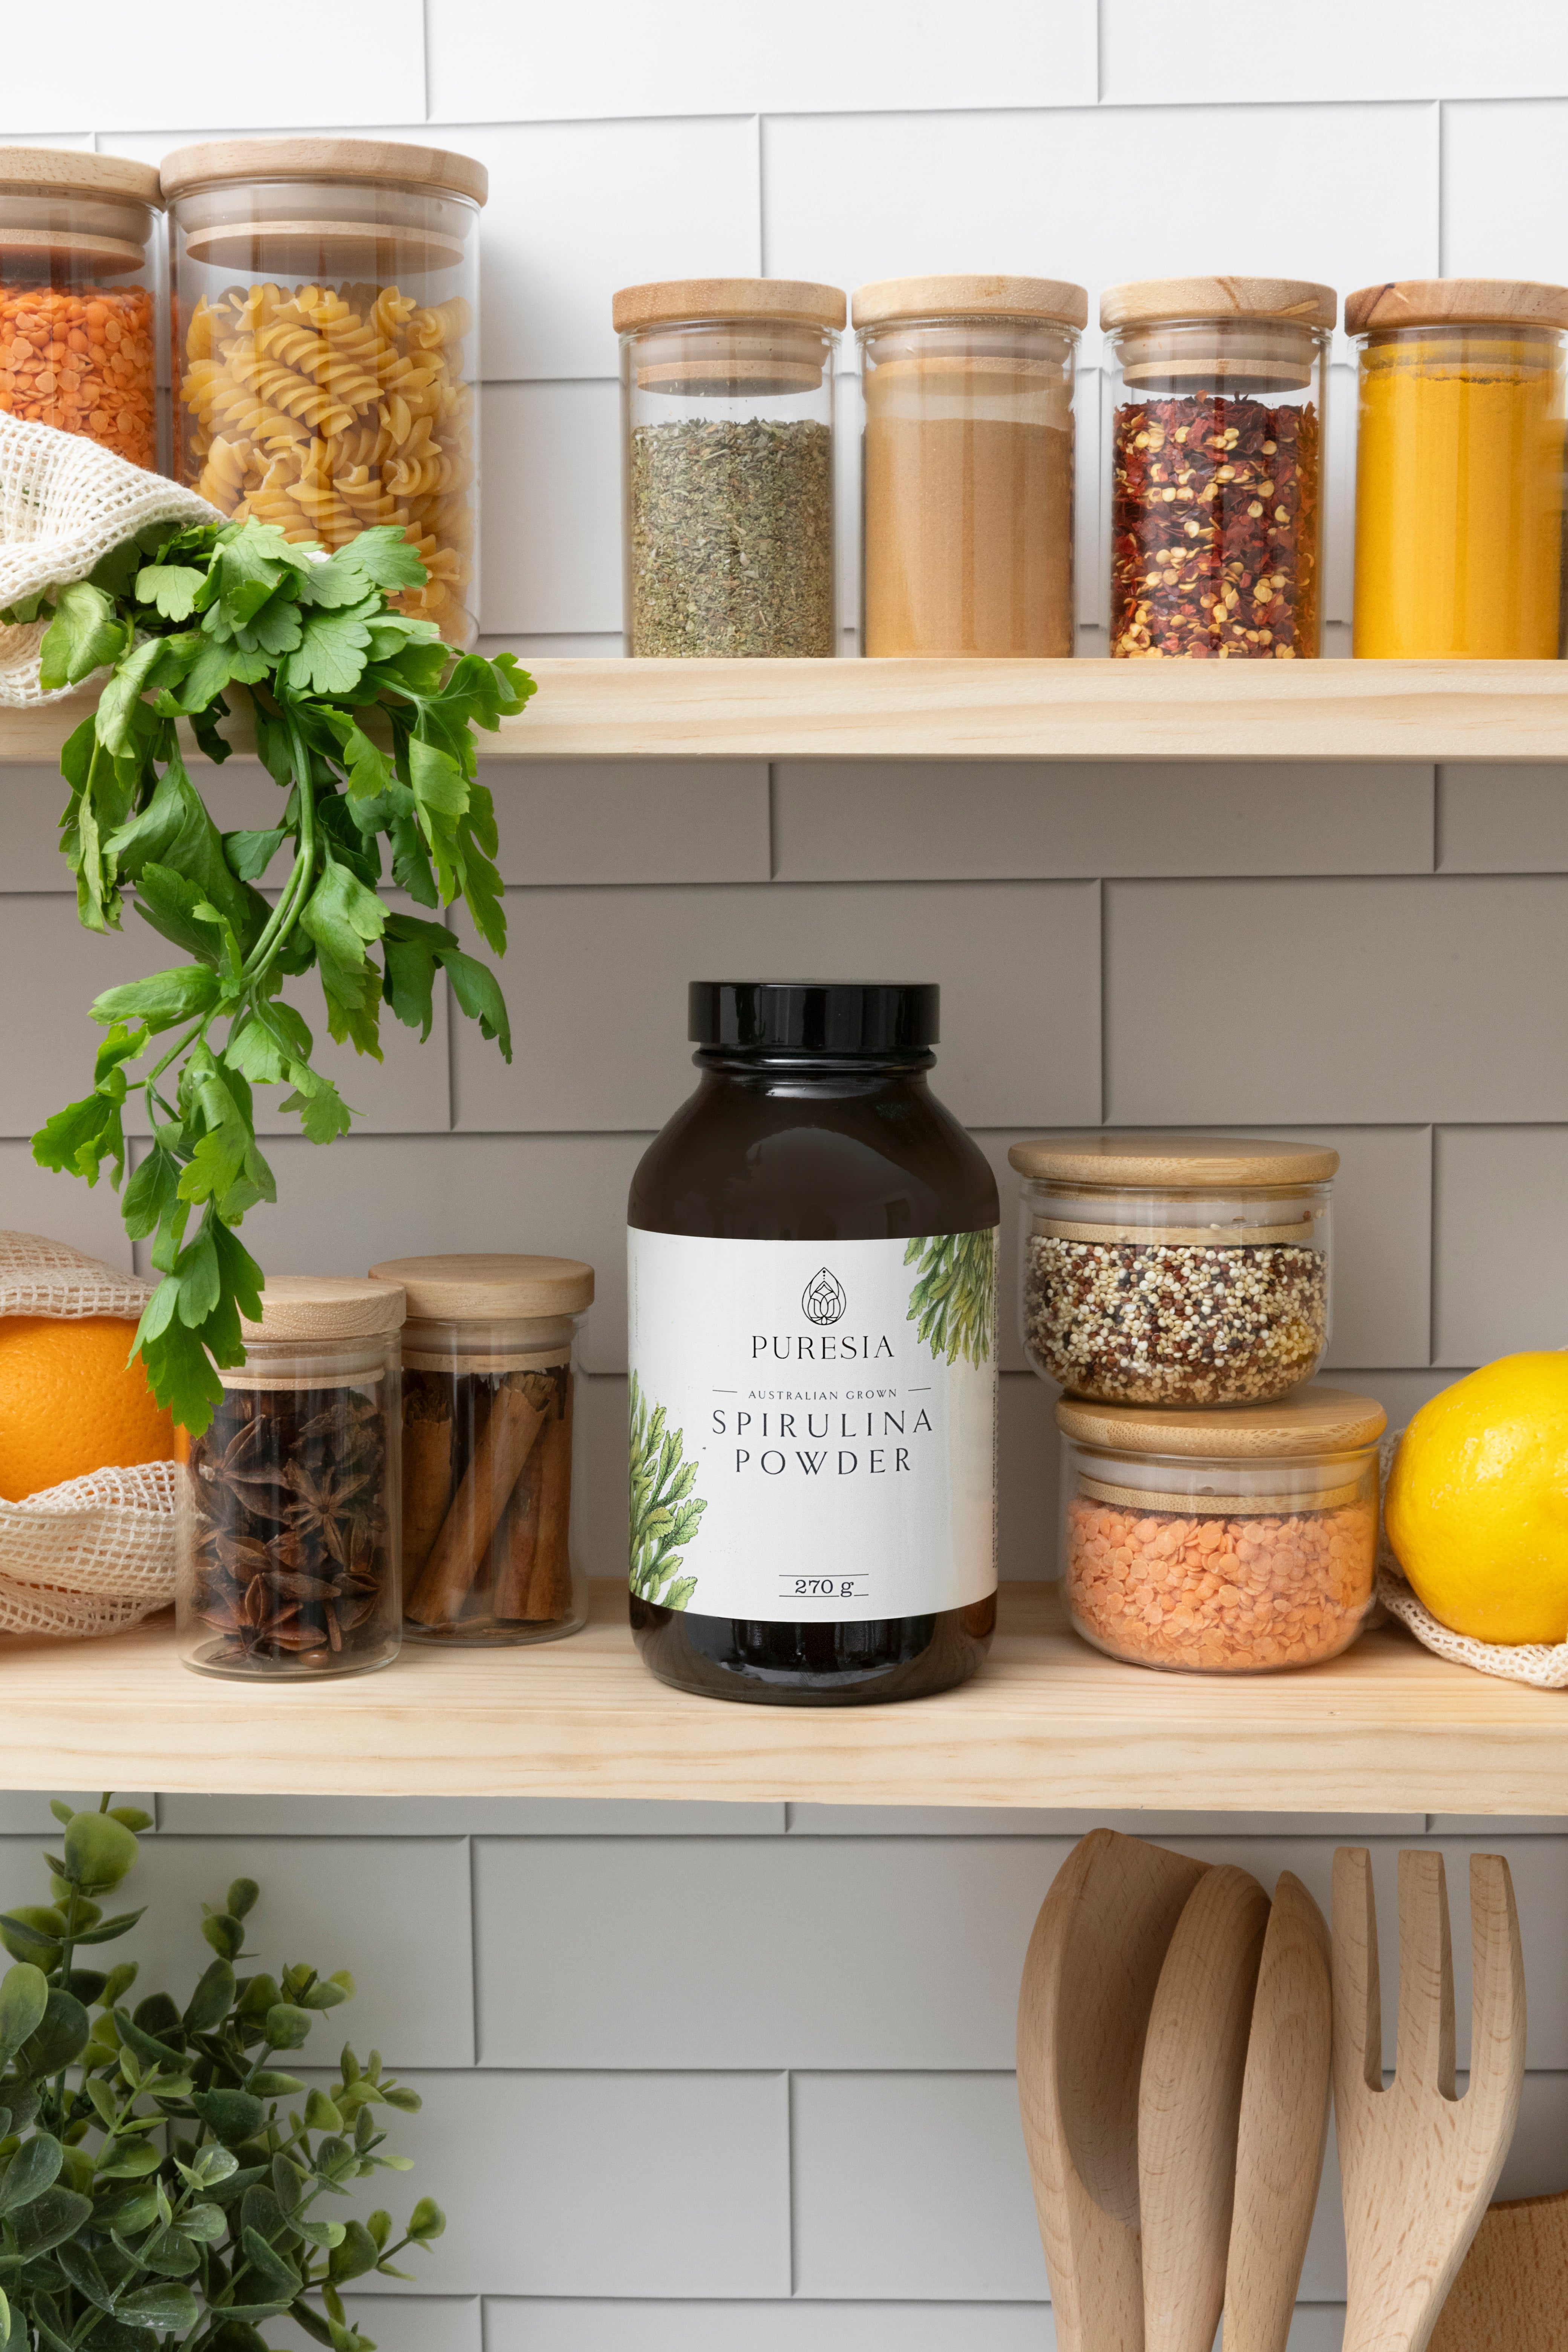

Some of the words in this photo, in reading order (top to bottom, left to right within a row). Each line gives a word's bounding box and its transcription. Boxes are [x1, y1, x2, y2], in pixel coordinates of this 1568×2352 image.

[752, 1335, 894, 1360] PURESIA
[749, 1390, 838, 1400] AUSTRALIAN
[846, 1389, 897, 1400] GROWN
[712, 1408, 933, 1438] SPIRULINA
[736, 1447, 911, 1475] POWDER
[795, 1579, 833, 1594] 270
[841, 1582, 854, 1597] g
